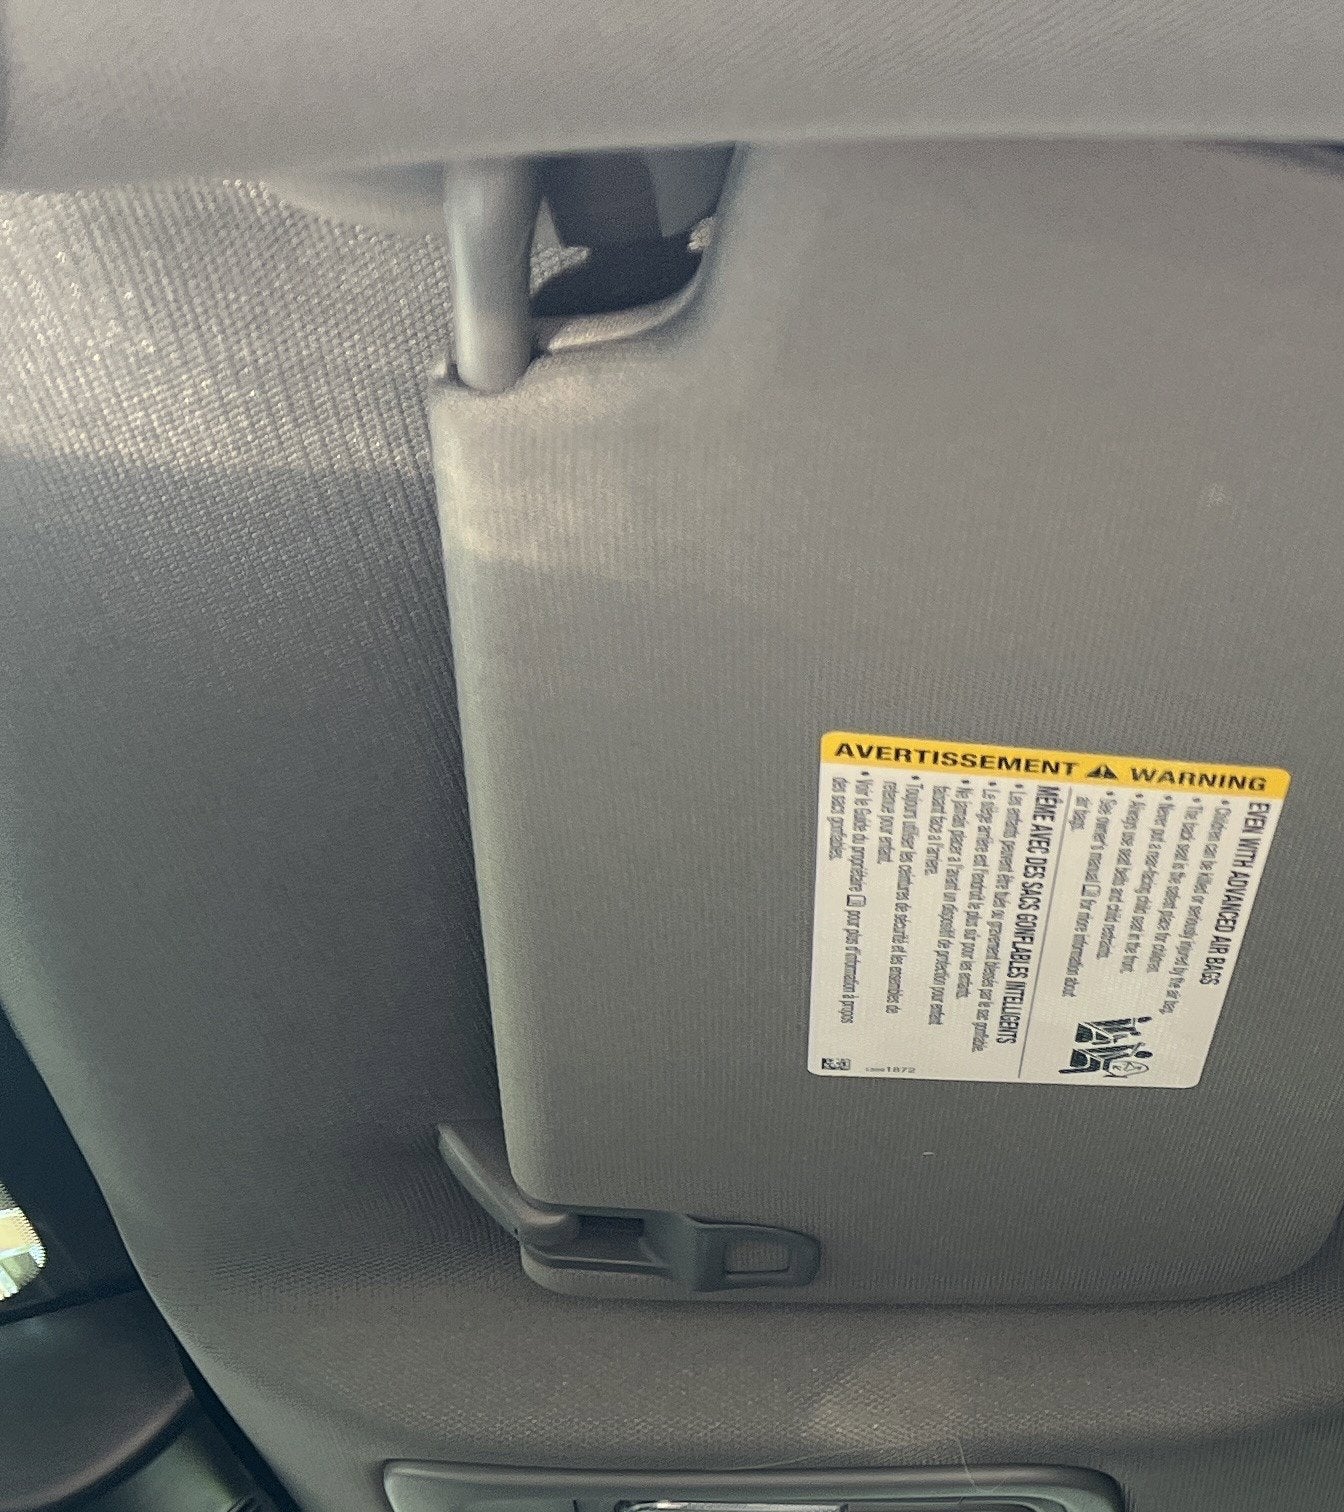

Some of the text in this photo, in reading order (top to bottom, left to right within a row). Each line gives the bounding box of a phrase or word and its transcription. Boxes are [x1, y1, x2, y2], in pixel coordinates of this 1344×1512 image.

[834, 742, 1268, 792] AVERTISSEMENT WARNING
[1241, 801, 1272, 834] EVEN
[1026, 823, 1054, 854] AVEC
[1231, 836, 1262, 868] WITH
[1017, 880, 1043, 910] SACS
[1213, 870, 1252, 933] ADVANCED
[1006, 912, 1038, 978] GONFLABLES
[995, 980, 1026, 1044] INTELLIGENTS
